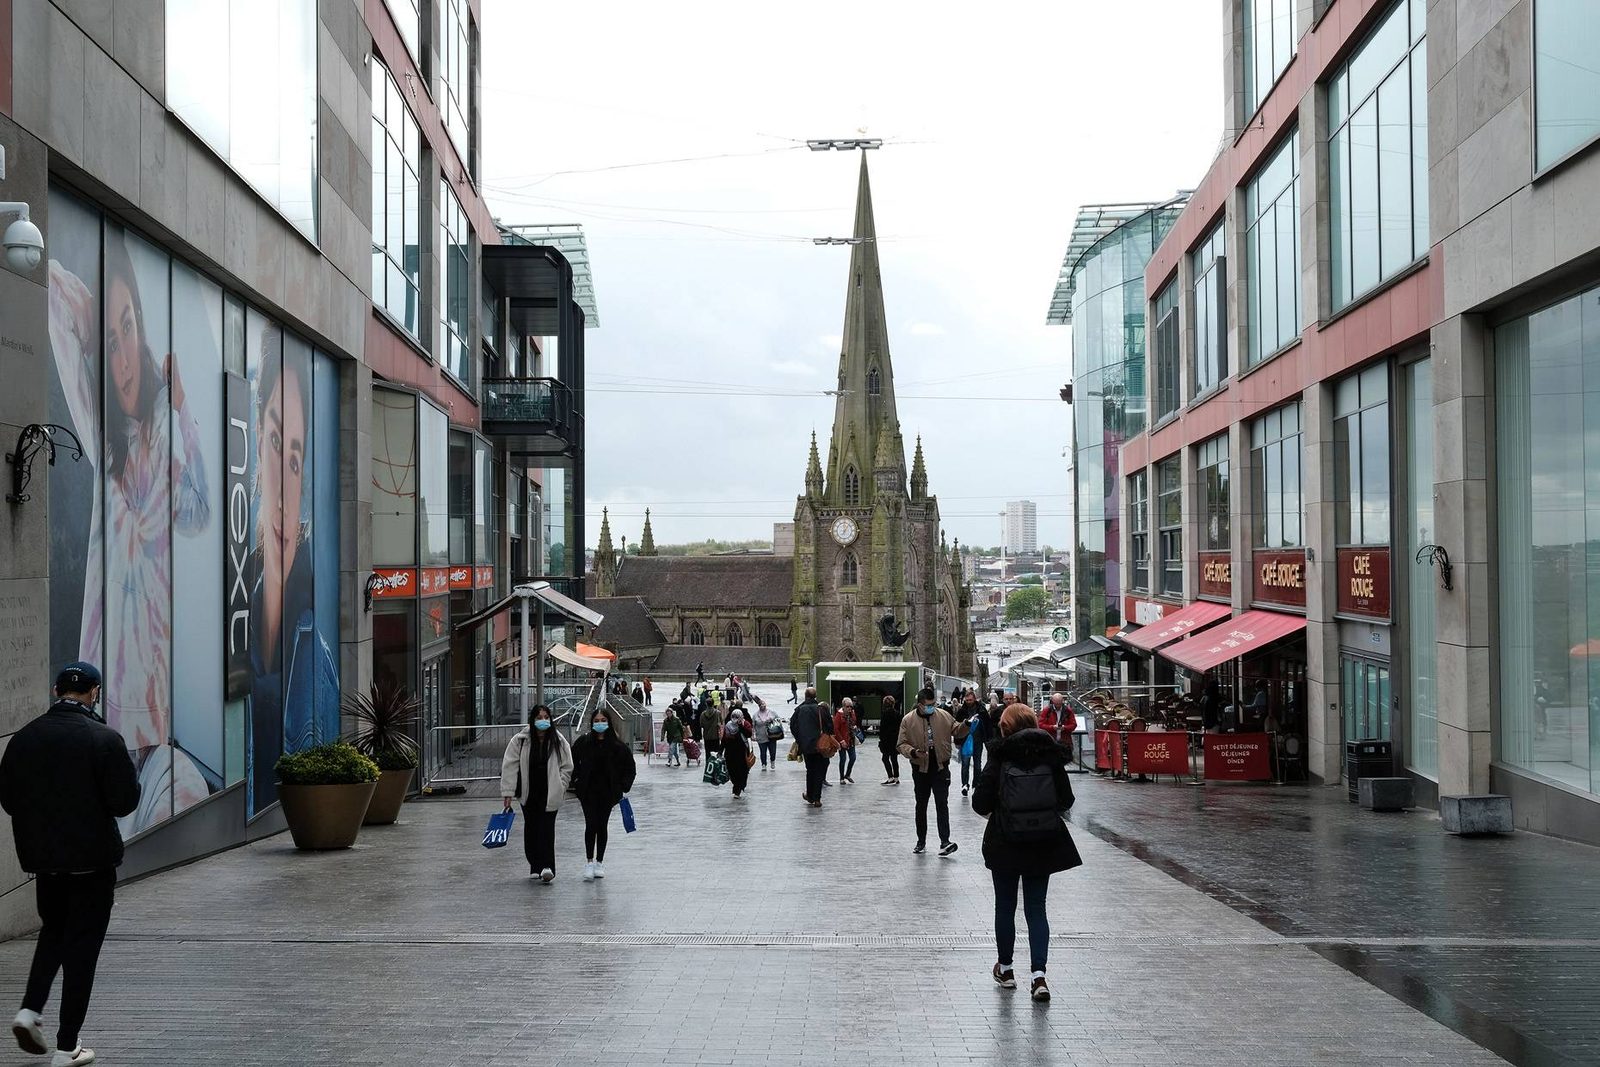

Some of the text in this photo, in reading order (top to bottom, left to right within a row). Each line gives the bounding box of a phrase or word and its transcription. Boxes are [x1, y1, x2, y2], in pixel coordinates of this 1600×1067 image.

[230, 417, 249, 656] next
[1203, 560, 1215, 581] CAFÉ
[1261, 561, 1301, 588] CAFÉ ROUGE
[1353, 553, 1371, 575] CAFÉ
[1350, 578, 1374, 597] ROUGE
[1144, 751, 1170, 759] ROUGE
[1147, 743, 1166, 751] CAFÉ
